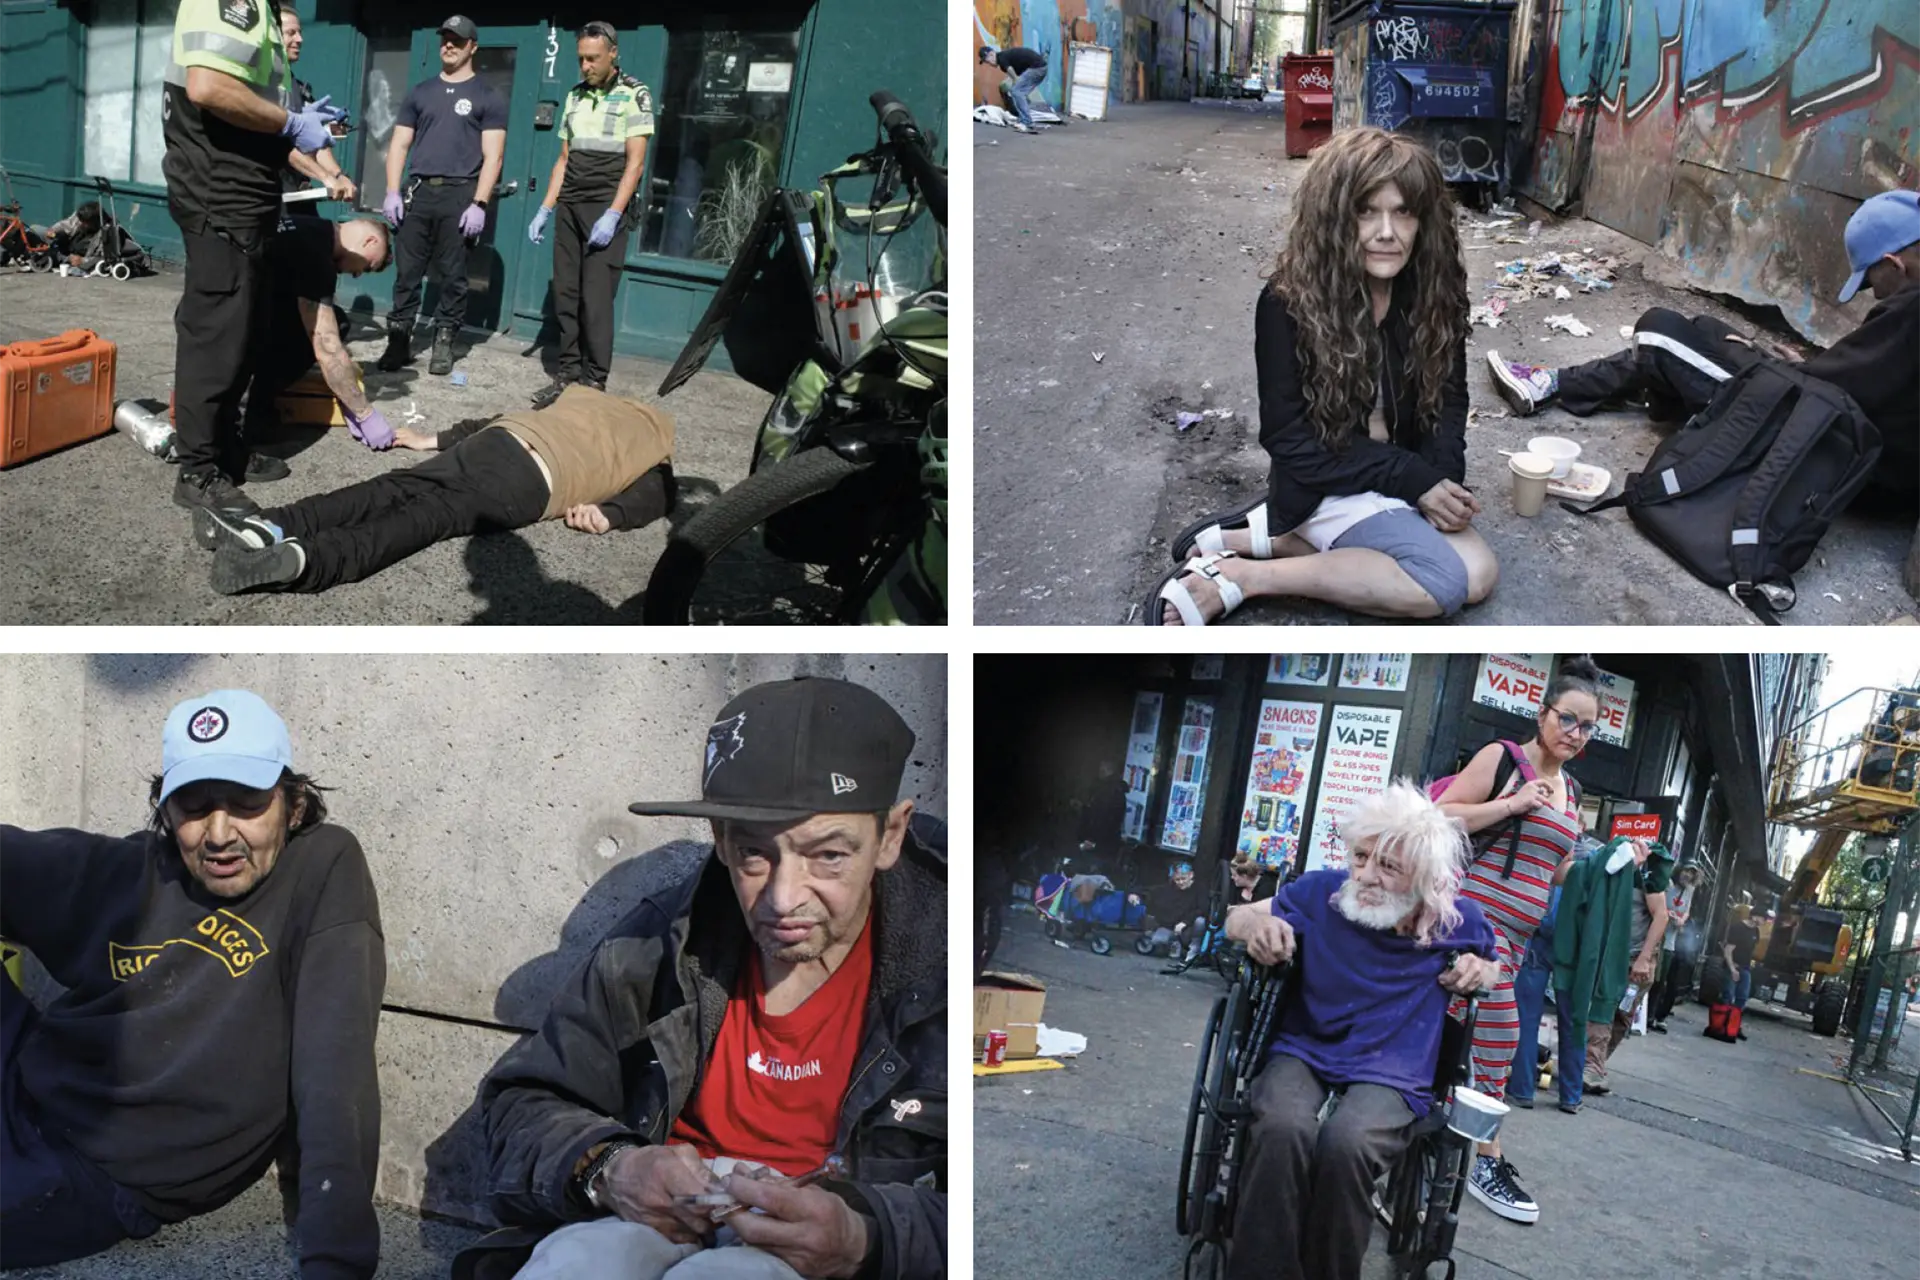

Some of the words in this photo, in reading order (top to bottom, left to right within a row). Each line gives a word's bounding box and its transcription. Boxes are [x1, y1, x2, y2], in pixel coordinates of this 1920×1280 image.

[1489, 655, 1547, 681] DISPOSABLE
[1488, 668, 1544, 705] VAPE
[1481, 694, 1509, 711] SELL
[1263, 706, 1317, 726] SNACKS
[1336, 711, 1391, 724] DISPOSABLE
[1336, 725, 1390, 748] VAPE
[1333, 760, 1357, 769] GLASS
[1616, 820, 1632, 830] Sim
[1634, 820, 1656, 830] Card
[196, 915, 255, 968] DICES
[764, 1059, 821, 1081] CANADIAN
